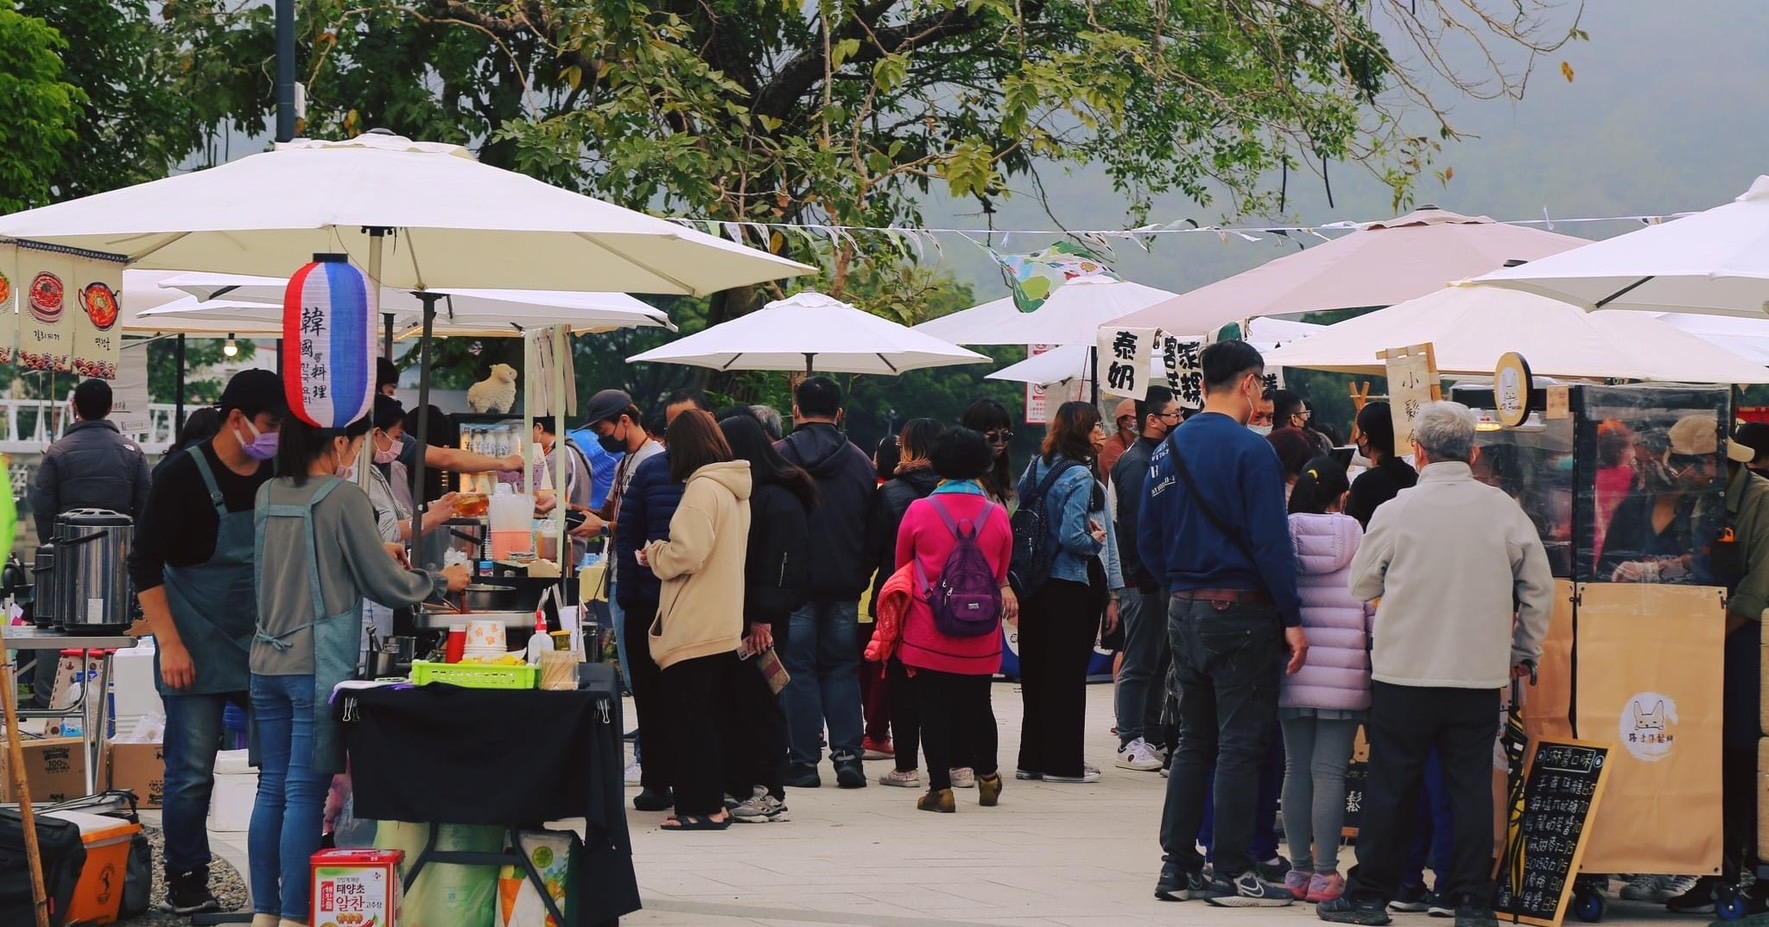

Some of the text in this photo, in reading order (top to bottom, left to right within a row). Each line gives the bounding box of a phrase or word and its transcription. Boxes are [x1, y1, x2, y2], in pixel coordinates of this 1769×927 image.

[1107, 331, 1138, 391] 泰奶
[336, 883, 366, 895] 태양초
[335, 895, 366, 912] 알찬
